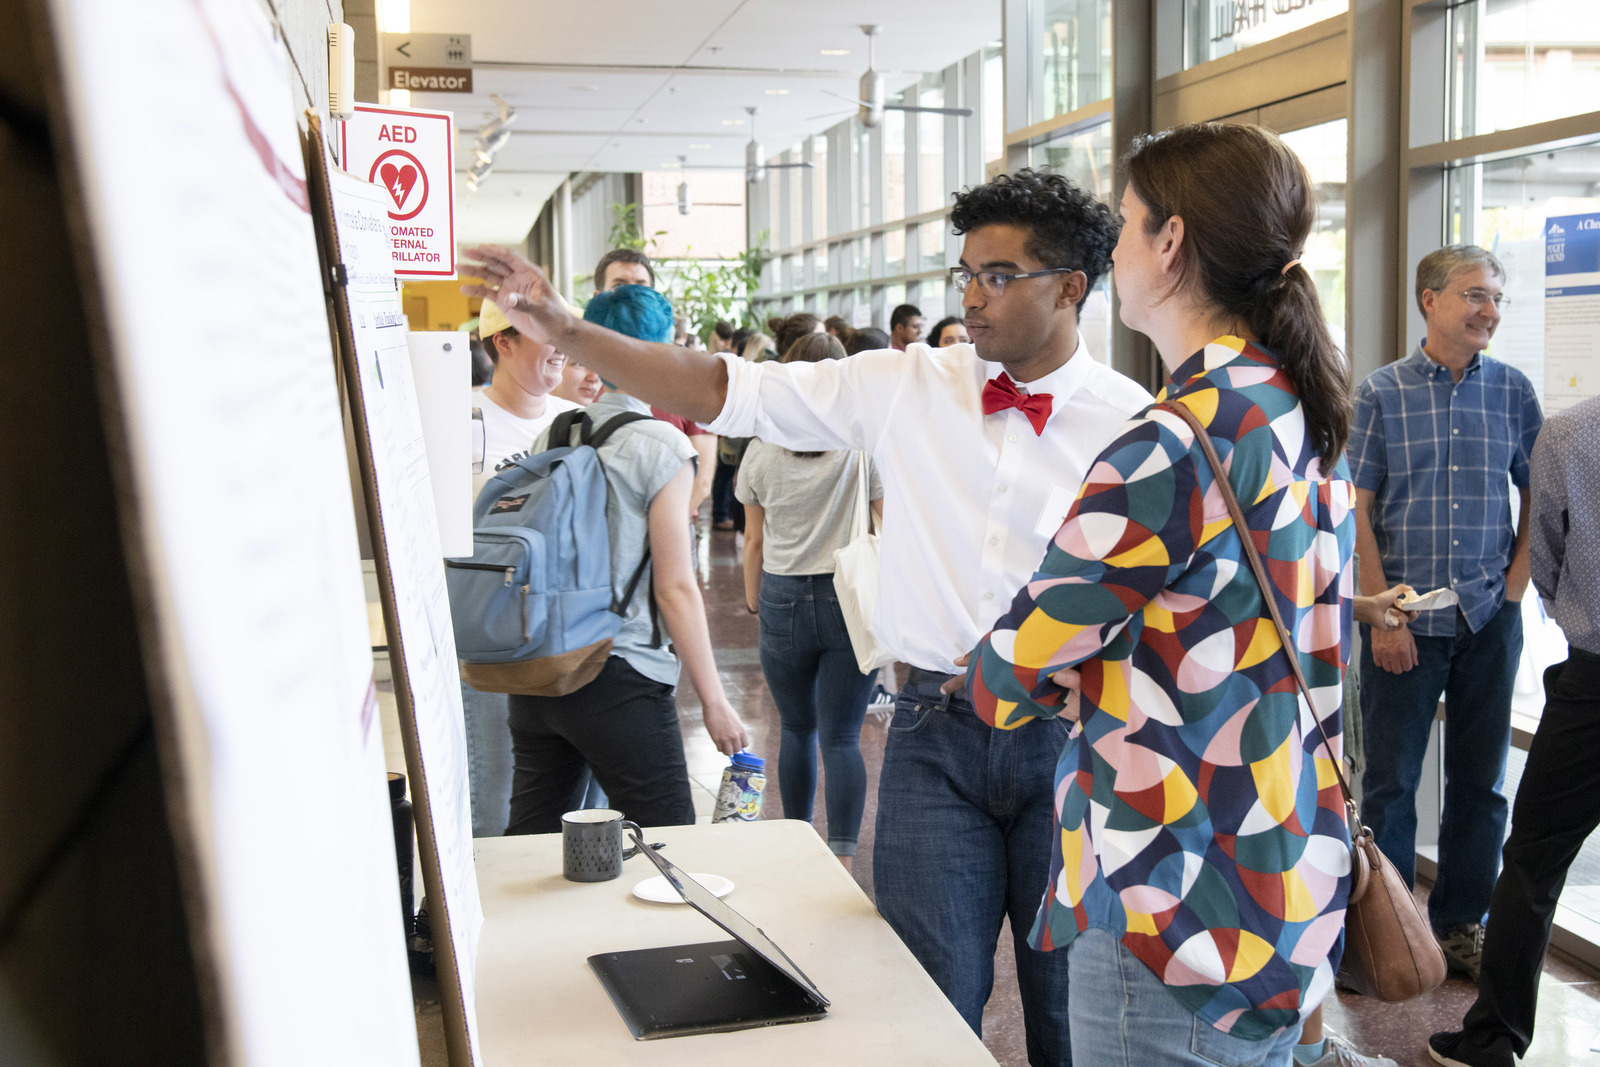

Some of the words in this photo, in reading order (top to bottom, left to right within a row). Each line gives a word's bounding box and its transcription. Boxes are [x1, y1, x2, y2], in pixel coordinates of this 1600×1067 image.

[394, 70, 467, 89] Elevator
[378, 124, 417, 143] AED
[389, 226, 434, 237] OMATED
[391, 238, 428, 249] ERNAL
